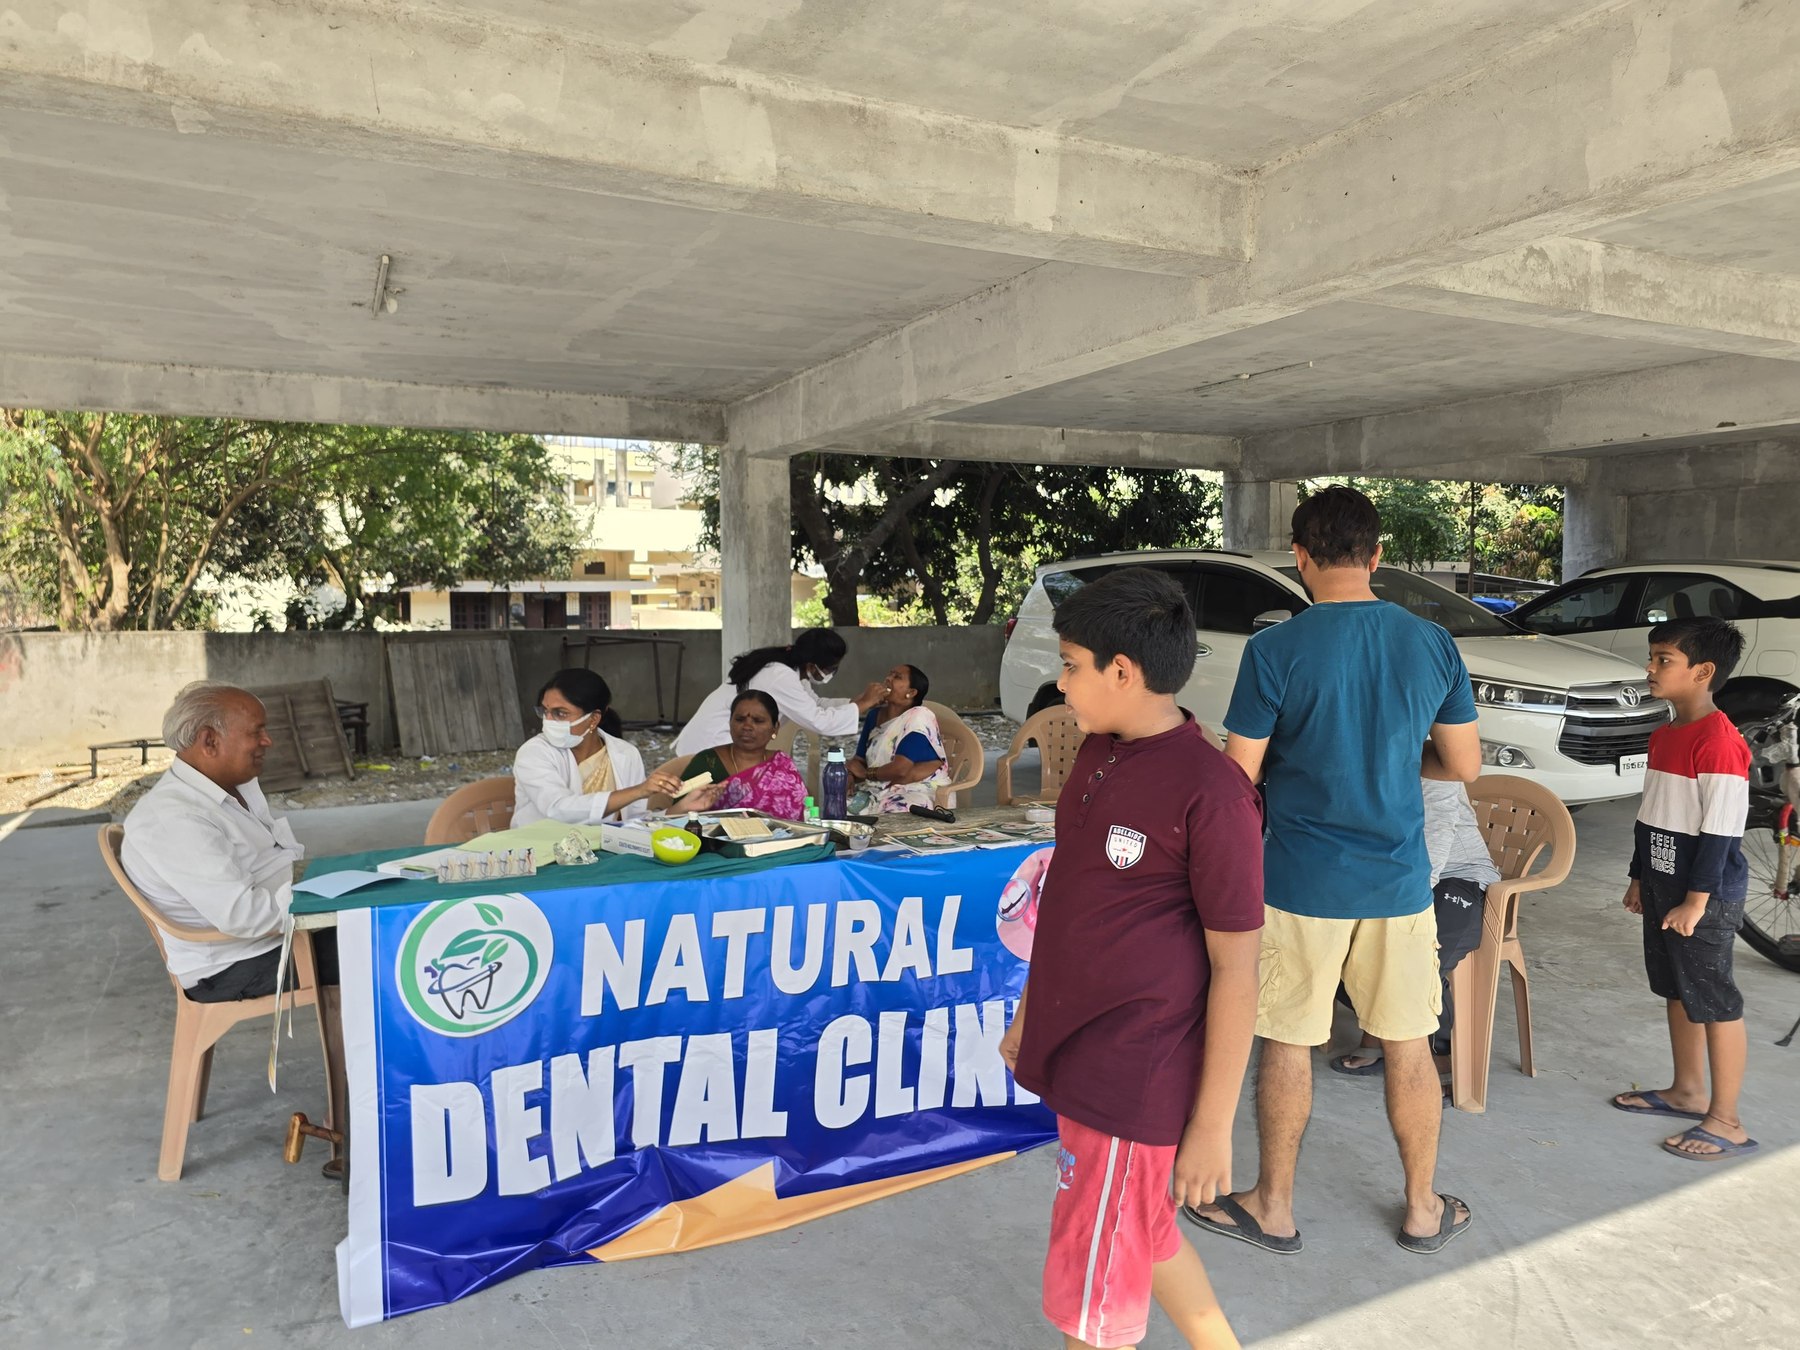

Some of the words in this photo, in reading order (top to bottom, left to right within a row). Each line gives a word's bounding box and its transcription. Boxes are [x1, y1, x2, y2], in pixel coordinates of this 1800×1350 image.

[1650, 831, 1677, 850] FEEL
[1650, 844, 1676, 862] GOOD
[1650, 856, 1676, 875] VIBES
[581, 895, 973, 1016] NATURAL
[410, 1028, 788, 1207] DENTAL
